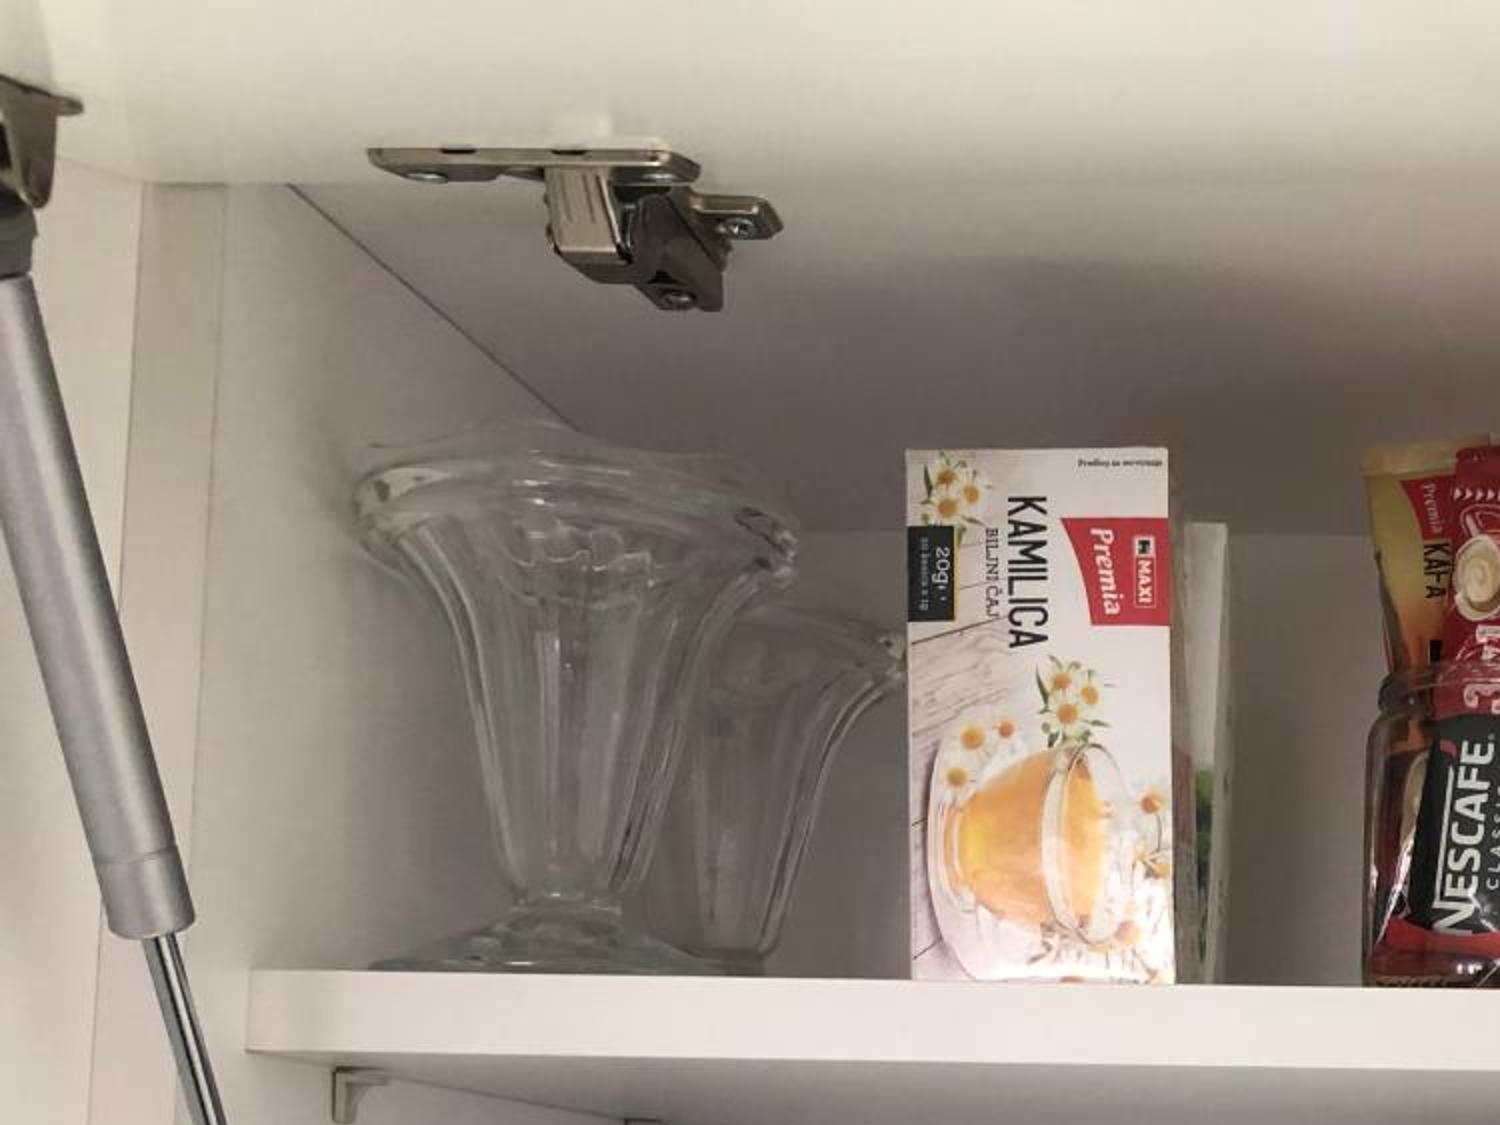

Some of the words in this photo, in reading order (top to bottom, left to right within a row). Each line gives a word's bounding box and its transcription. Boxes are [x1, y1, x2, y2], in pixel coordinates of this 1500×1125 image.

[985, 528, 999, 581] BILJNI
[1007, 496, 1049, 649] KAMILICA
[1090, 528, 1125, 615] Premia
[985, 585, 1002, 618] ČAJ
[1137, 559, 1153, 604] MAXI
